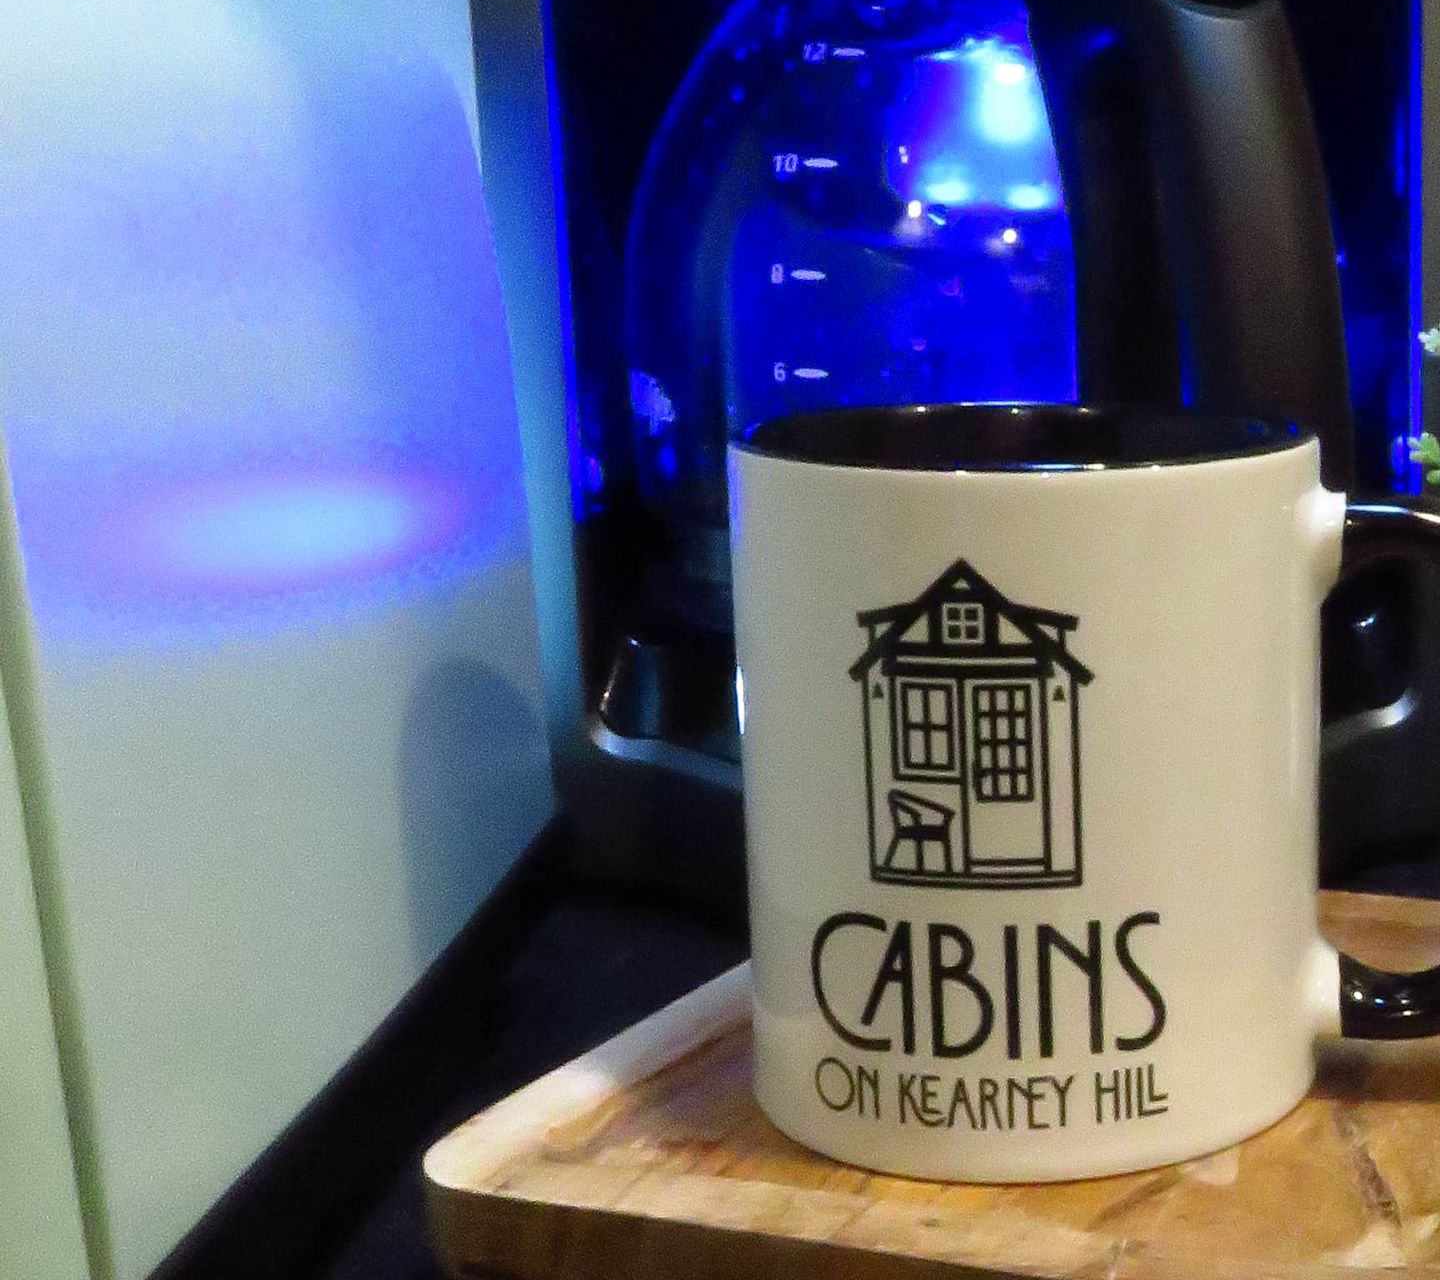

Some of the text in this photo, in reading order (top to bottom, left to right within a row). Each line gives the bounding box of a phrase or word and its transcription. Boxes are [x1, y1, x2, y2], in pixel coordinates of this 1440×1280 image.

[803, 42, 826, 61] 12
[773, 153, 798, 173] 10
[774, 362, 786, 382] 6
[810, 911, 1168, 1059] CABINS
[814, 1057, 1169, 1130] ON KEARNEY HILL
